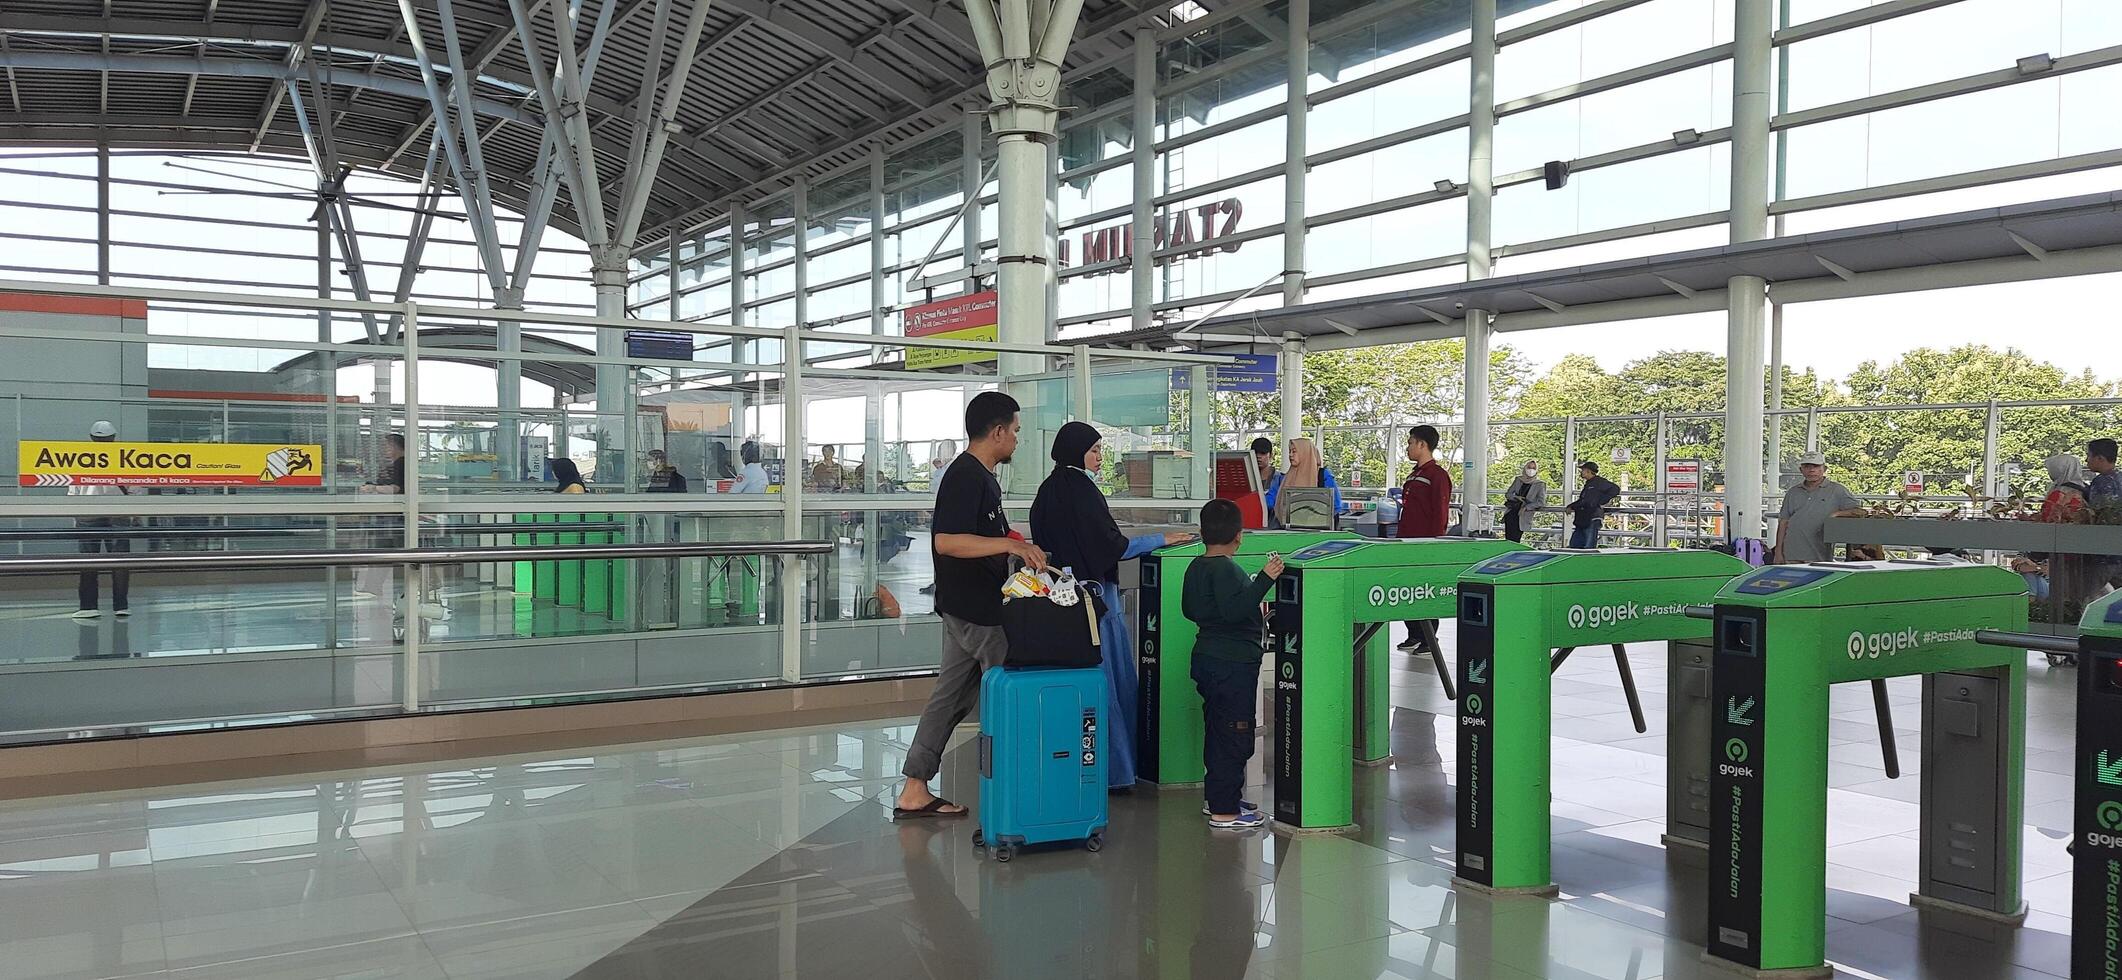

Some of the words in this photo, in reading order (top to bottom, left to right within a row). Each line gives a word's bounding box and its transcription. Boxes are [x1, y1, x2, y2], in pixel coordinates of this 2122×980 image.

[35, 448, 109, 469] Awas
[120, 449, 191, 469] Kaca
[80, 477, 116, 485] Dilarang
[159, 476, 169, 484] Di
[1388, 582, 1436, 606] gojek
[1588, 600, 1639, 628] gojek
[1868, 626, 1919, 659] gojek
[1279, 680, 1297, 690] gojek
[1462, 715, 1486, 727] gojek
[1719, 763, 1753, 778] gojek
[1729, 785, 1742, 899] #PastiAdaJalan
